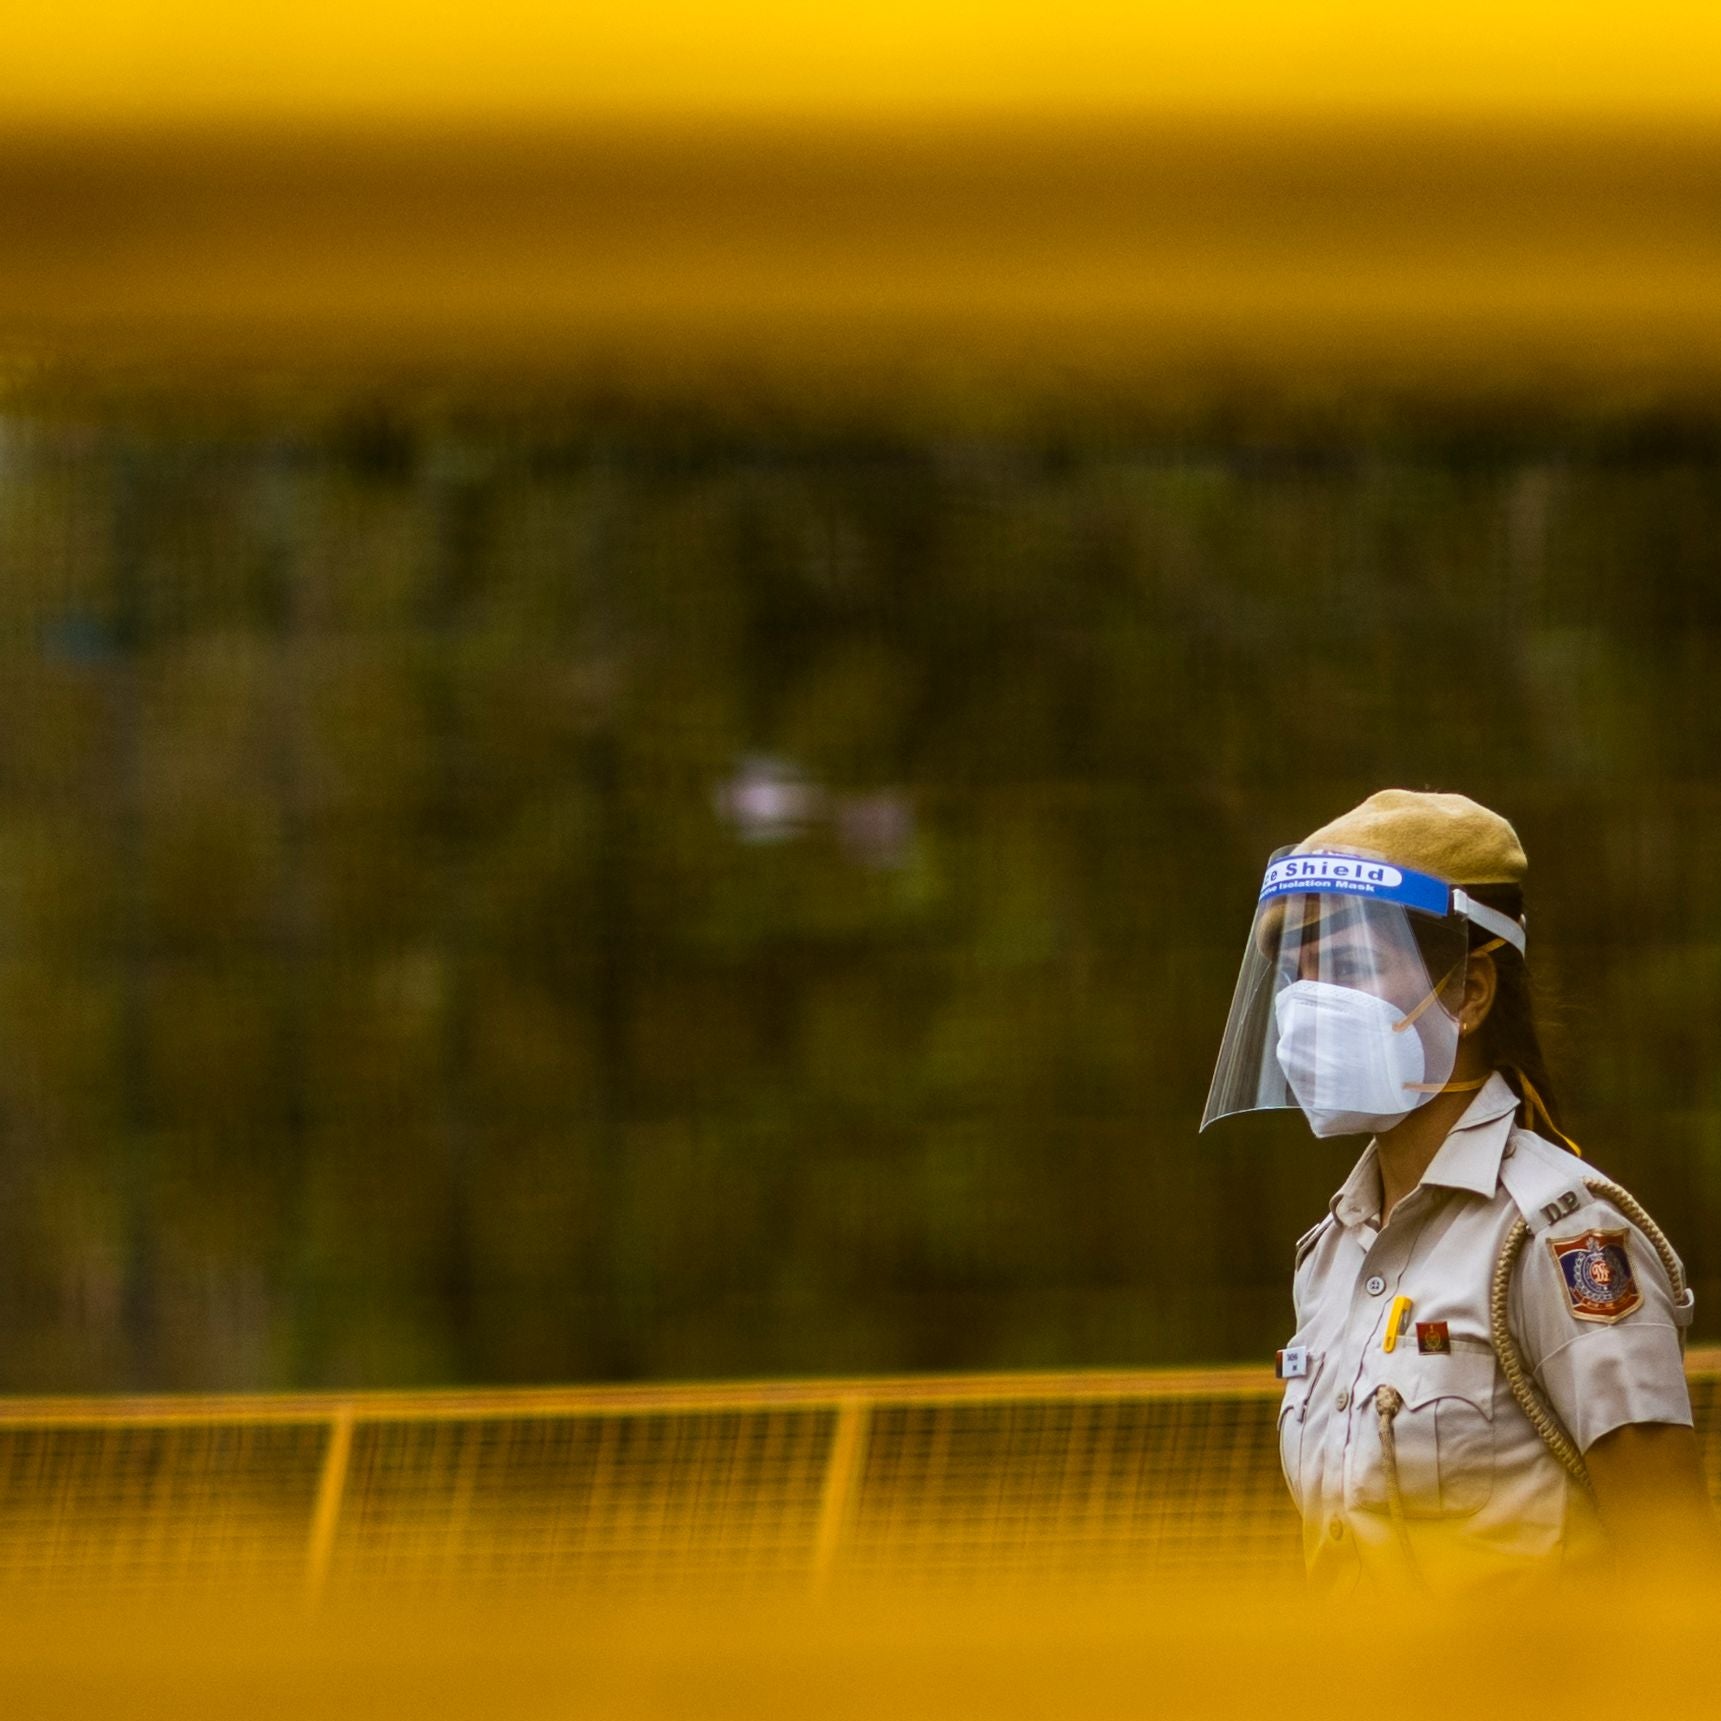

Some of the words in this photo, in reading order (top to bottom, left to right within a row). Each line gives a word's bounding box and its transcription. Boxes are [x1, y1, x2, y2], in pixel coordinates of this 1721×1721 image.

[1285, 863, 1383, 881] Shield
[1279, 880, 1331, 890] Isolation
[1335, 881, 1375, 893] Mask
